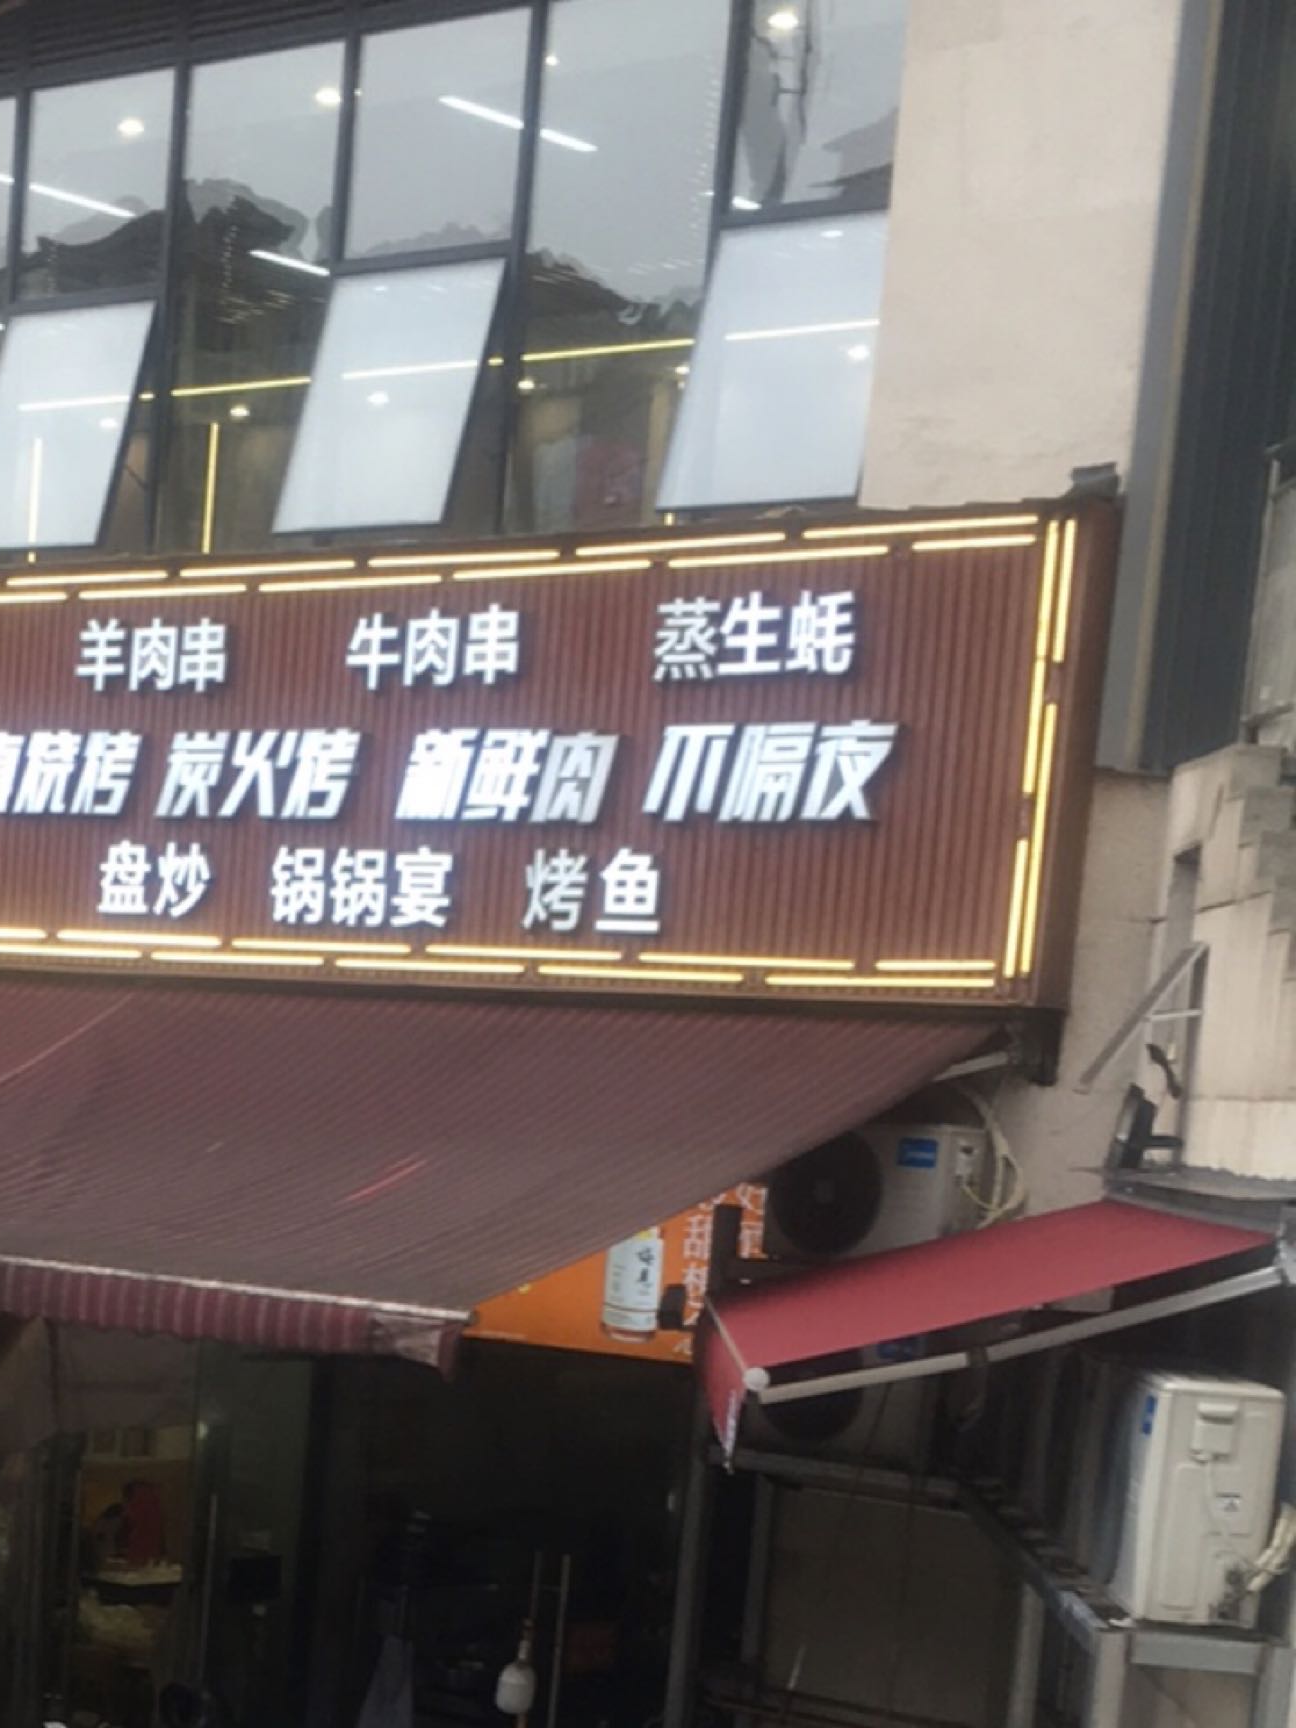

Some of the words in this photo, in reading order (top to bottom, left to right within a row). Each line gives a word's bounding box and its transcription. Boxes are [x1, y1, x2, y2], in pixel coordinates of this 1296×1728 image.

[76, 618, 227, 692] 羊肉串
[346, 603, 520, 690] 牛肉串
[653, 591, 856, 682] 蒸生蚝
[154, 728, 361, 818] 炭火烤
[394, 728, 619, 824] 新鲜肉
[642, 720, 898, 822] 不隔夜
[96, 840, 212, 919] 盘炒
[269, 845, 454, 928] 锅锅宴
[523, 847, 661, 934] 烤鱼
